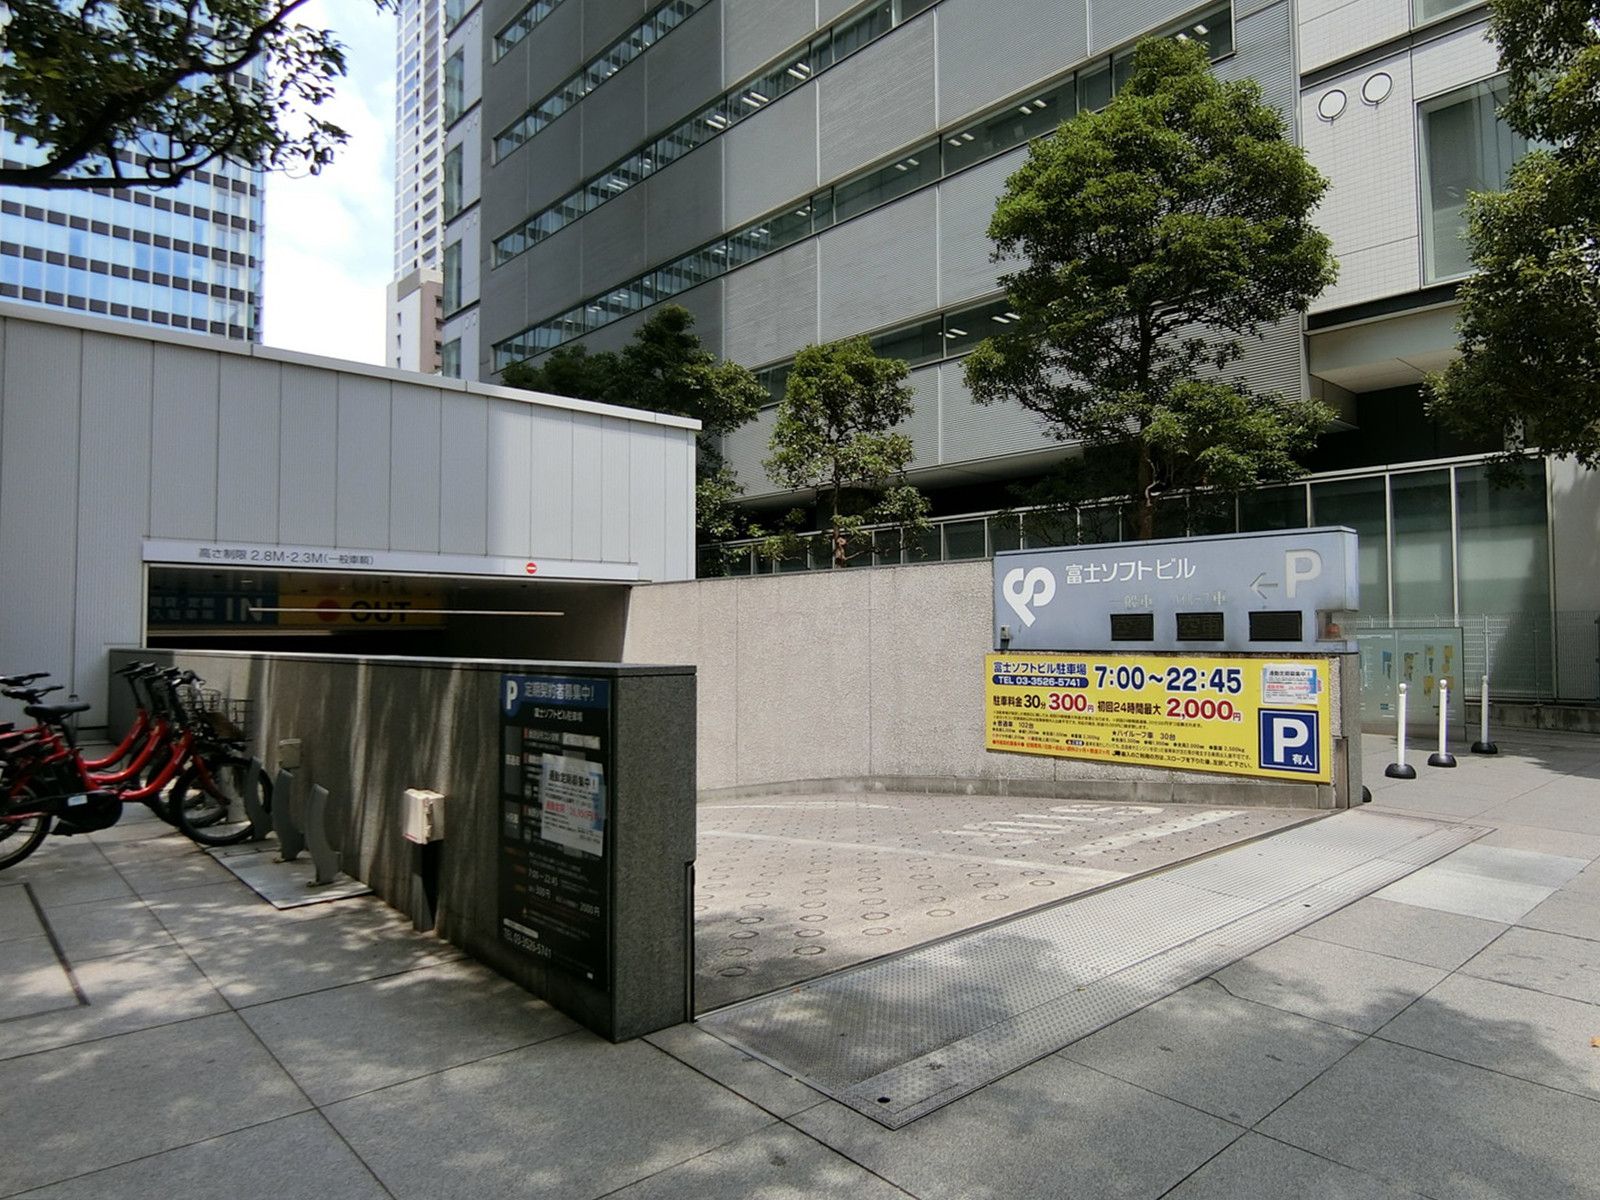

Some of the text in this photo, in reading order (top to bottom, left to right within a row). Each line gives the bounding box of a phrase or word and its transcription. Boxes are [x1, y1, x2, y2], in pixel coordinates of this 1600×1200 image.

[199, 547, 247, 560] 高さ制限
[1064, 557, 1197, 586] 富士ソフトビル
[1285, 549, 1323, 598] P
[226, 597, 263, 622] IN
[351, 600, 411, 623] OUT
[993, 661, 1087, 676] 富士ソフトビル駐車場
[998, 676, 1081, 688] TEL 03-3526-5741
[506, 680, 519, 710] P
[993, 695, 1022, 707] 駐車料金
[1048, 692, 1095, 713] 300円
[1097, 701, 1162, 716] 初回24時間最大
[1166, 697, 1241, 722] 2,000円
[1273, 717, 1309, 763] P
[1292, 754, 1313, 766] 有人
